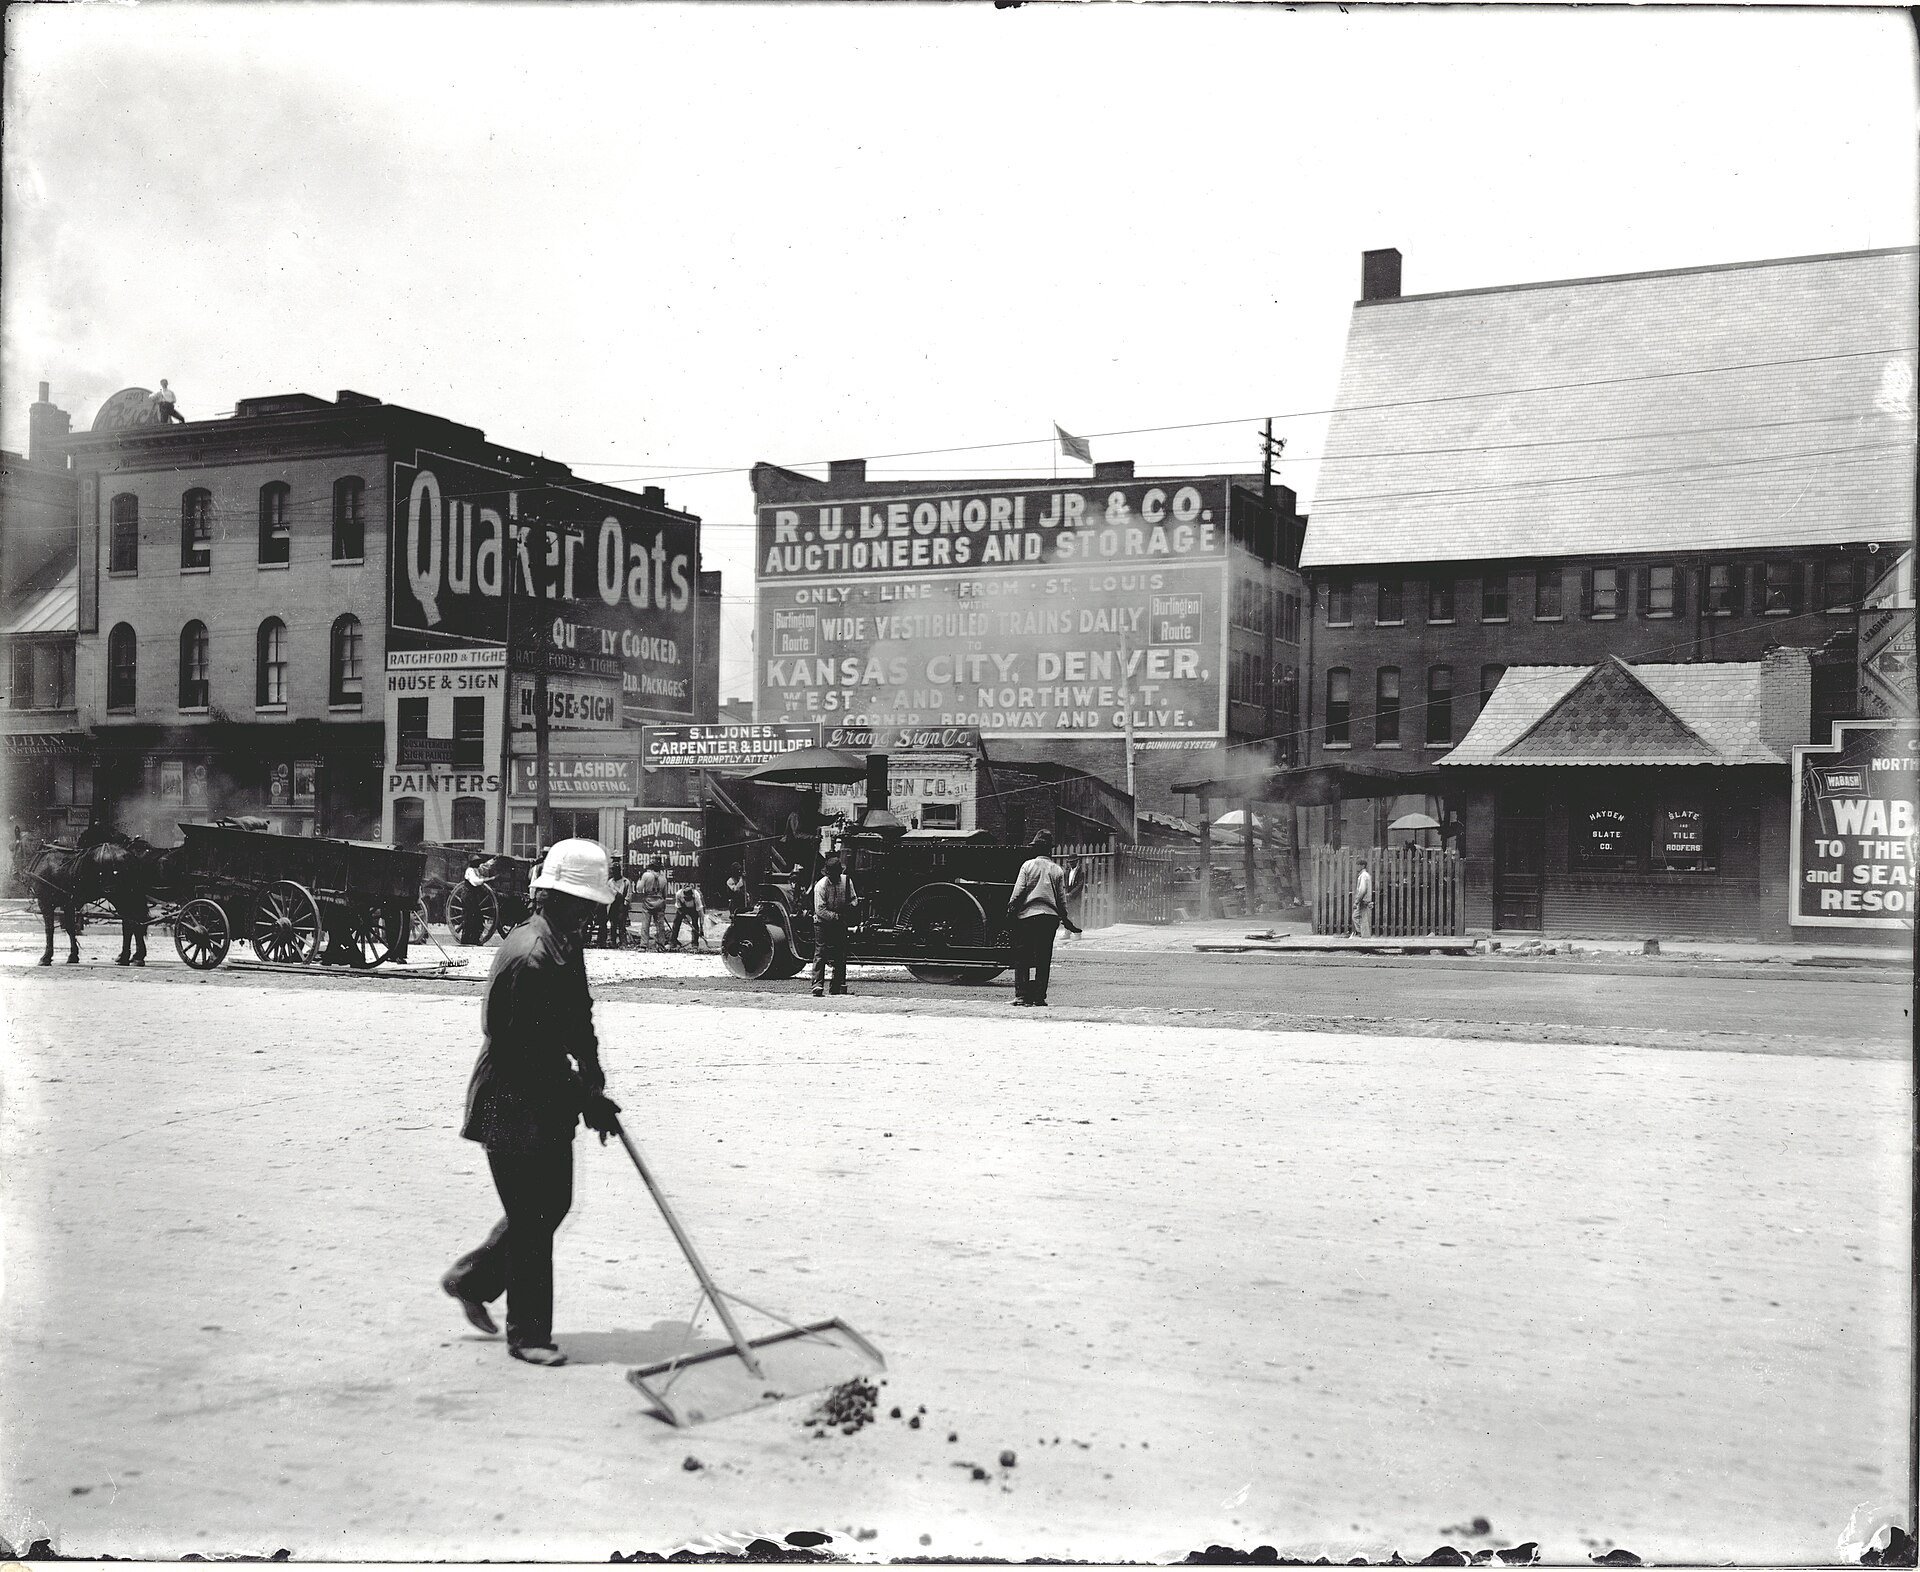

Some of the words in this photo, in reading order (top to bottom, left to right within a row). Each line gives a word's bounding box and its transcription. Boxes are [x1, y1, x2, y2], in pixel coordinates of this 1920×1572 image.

[1039, 492, 1095, 527] JR.
[1105, 491, 1130, 525] &
[1142, 486, 1212, 523] CO.
[765, 536, 972, 574] AUCTIONEERS
[982, 532, 1042, 562] AND
[1057, 523, 1216, 559] STORAGE
[597, 516, 690, 614] Oats
[795, 587, 852, 604] ONLY
[880, 584, 933, 601] LINE
[958, 579, 1019, 598] FROM
[1089, 574, 1165, 593] LOUIS
[1152, 597, 1200, 619] Burlington
[776, 611, 816, 632] Burlington
[821, 617, 865, 642] WIDE
[875, 612, 989, 641] VESTIBULED
[998, 608, 1072, 636] TRAINS
[1079, 606, 1145, 635] DAILY
[1160, 620, 1193, 641] Route
[782, 634, 809, 651] Route
[390, 652, 458, 665] RATCHFORD
[461, 654, 468, 662] &
[470, 651, 505, 662] TIGHE
[578, 657, 587, 670] &
[767, 655, 909, 688] KANSAS
[926, 653, 1020, 684] CITY,
[1037, 648, 1210, 682] DENVER,
[388, 675, 436, 691] HOUSE
[441, 675, 452, 690] &
[458, 674, 499, 690] SIGN
[892, 689, 943, 709] AND
[977, 685, 1168, 708] NORTHWEST.
[941, 711, 1048, 728] BROADWAY
[1056, 711, 1100, 728] AND
[1112, 710, 1195, 728] OLIVE.
[894, 729, 940, 748] Sign
[942, 728, 970, 747] Co.
[1146, 741, 1183, 750] GUNNING
[1184, 741, 1217, 749] SYSTEM
[659, 755, 695, 765] JOBBING
[697, 754, 741, 764] PROMPTLY
[389, 774, 500, 793] PAINTERS
[1827, 775, 1861, 788] WABASH
[1589, 810, 1625, 822] HAYDEN
[1668, 810, 1700, 821] SLATE
[1832, 799, 1915, 837] WAB
[628, 818, 661, 845] Ready
[661, 817, 702, 848] Roofing
[653, 839, 675, 848] AND
[1666, 844, 1702, 852] ROOFERS
[1815, 840, 1845, 857] TO
[1858, 840, 1906, 859] THE
[669, 850, 700, 867] Work
[1806, 864, 1843, 884] and
